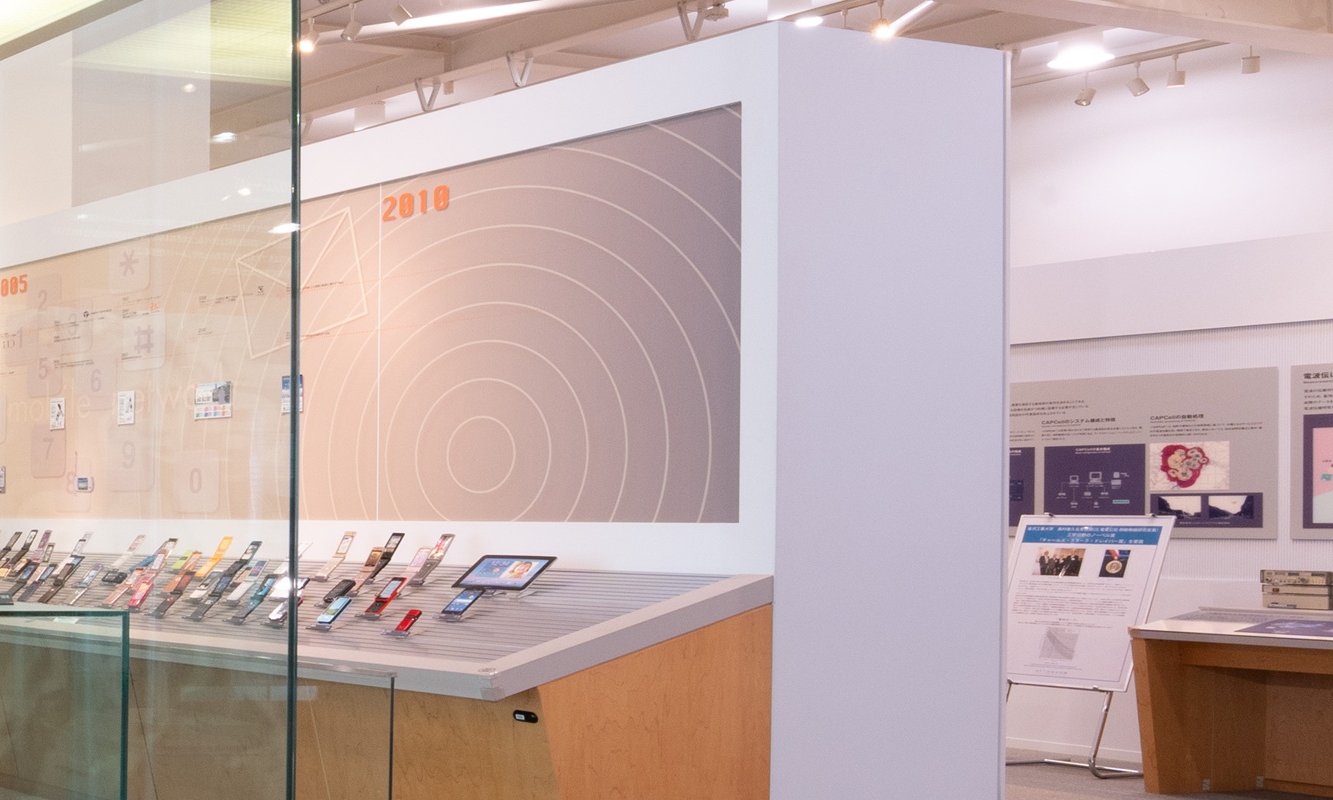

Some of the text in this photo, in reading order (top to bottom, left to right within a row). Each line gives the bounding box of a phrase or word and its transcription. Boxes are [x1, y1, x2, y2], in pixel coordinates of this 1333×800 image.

[382, 184, 450, 222] 2010
[1303, 371, 1333, 380] 電波伝
